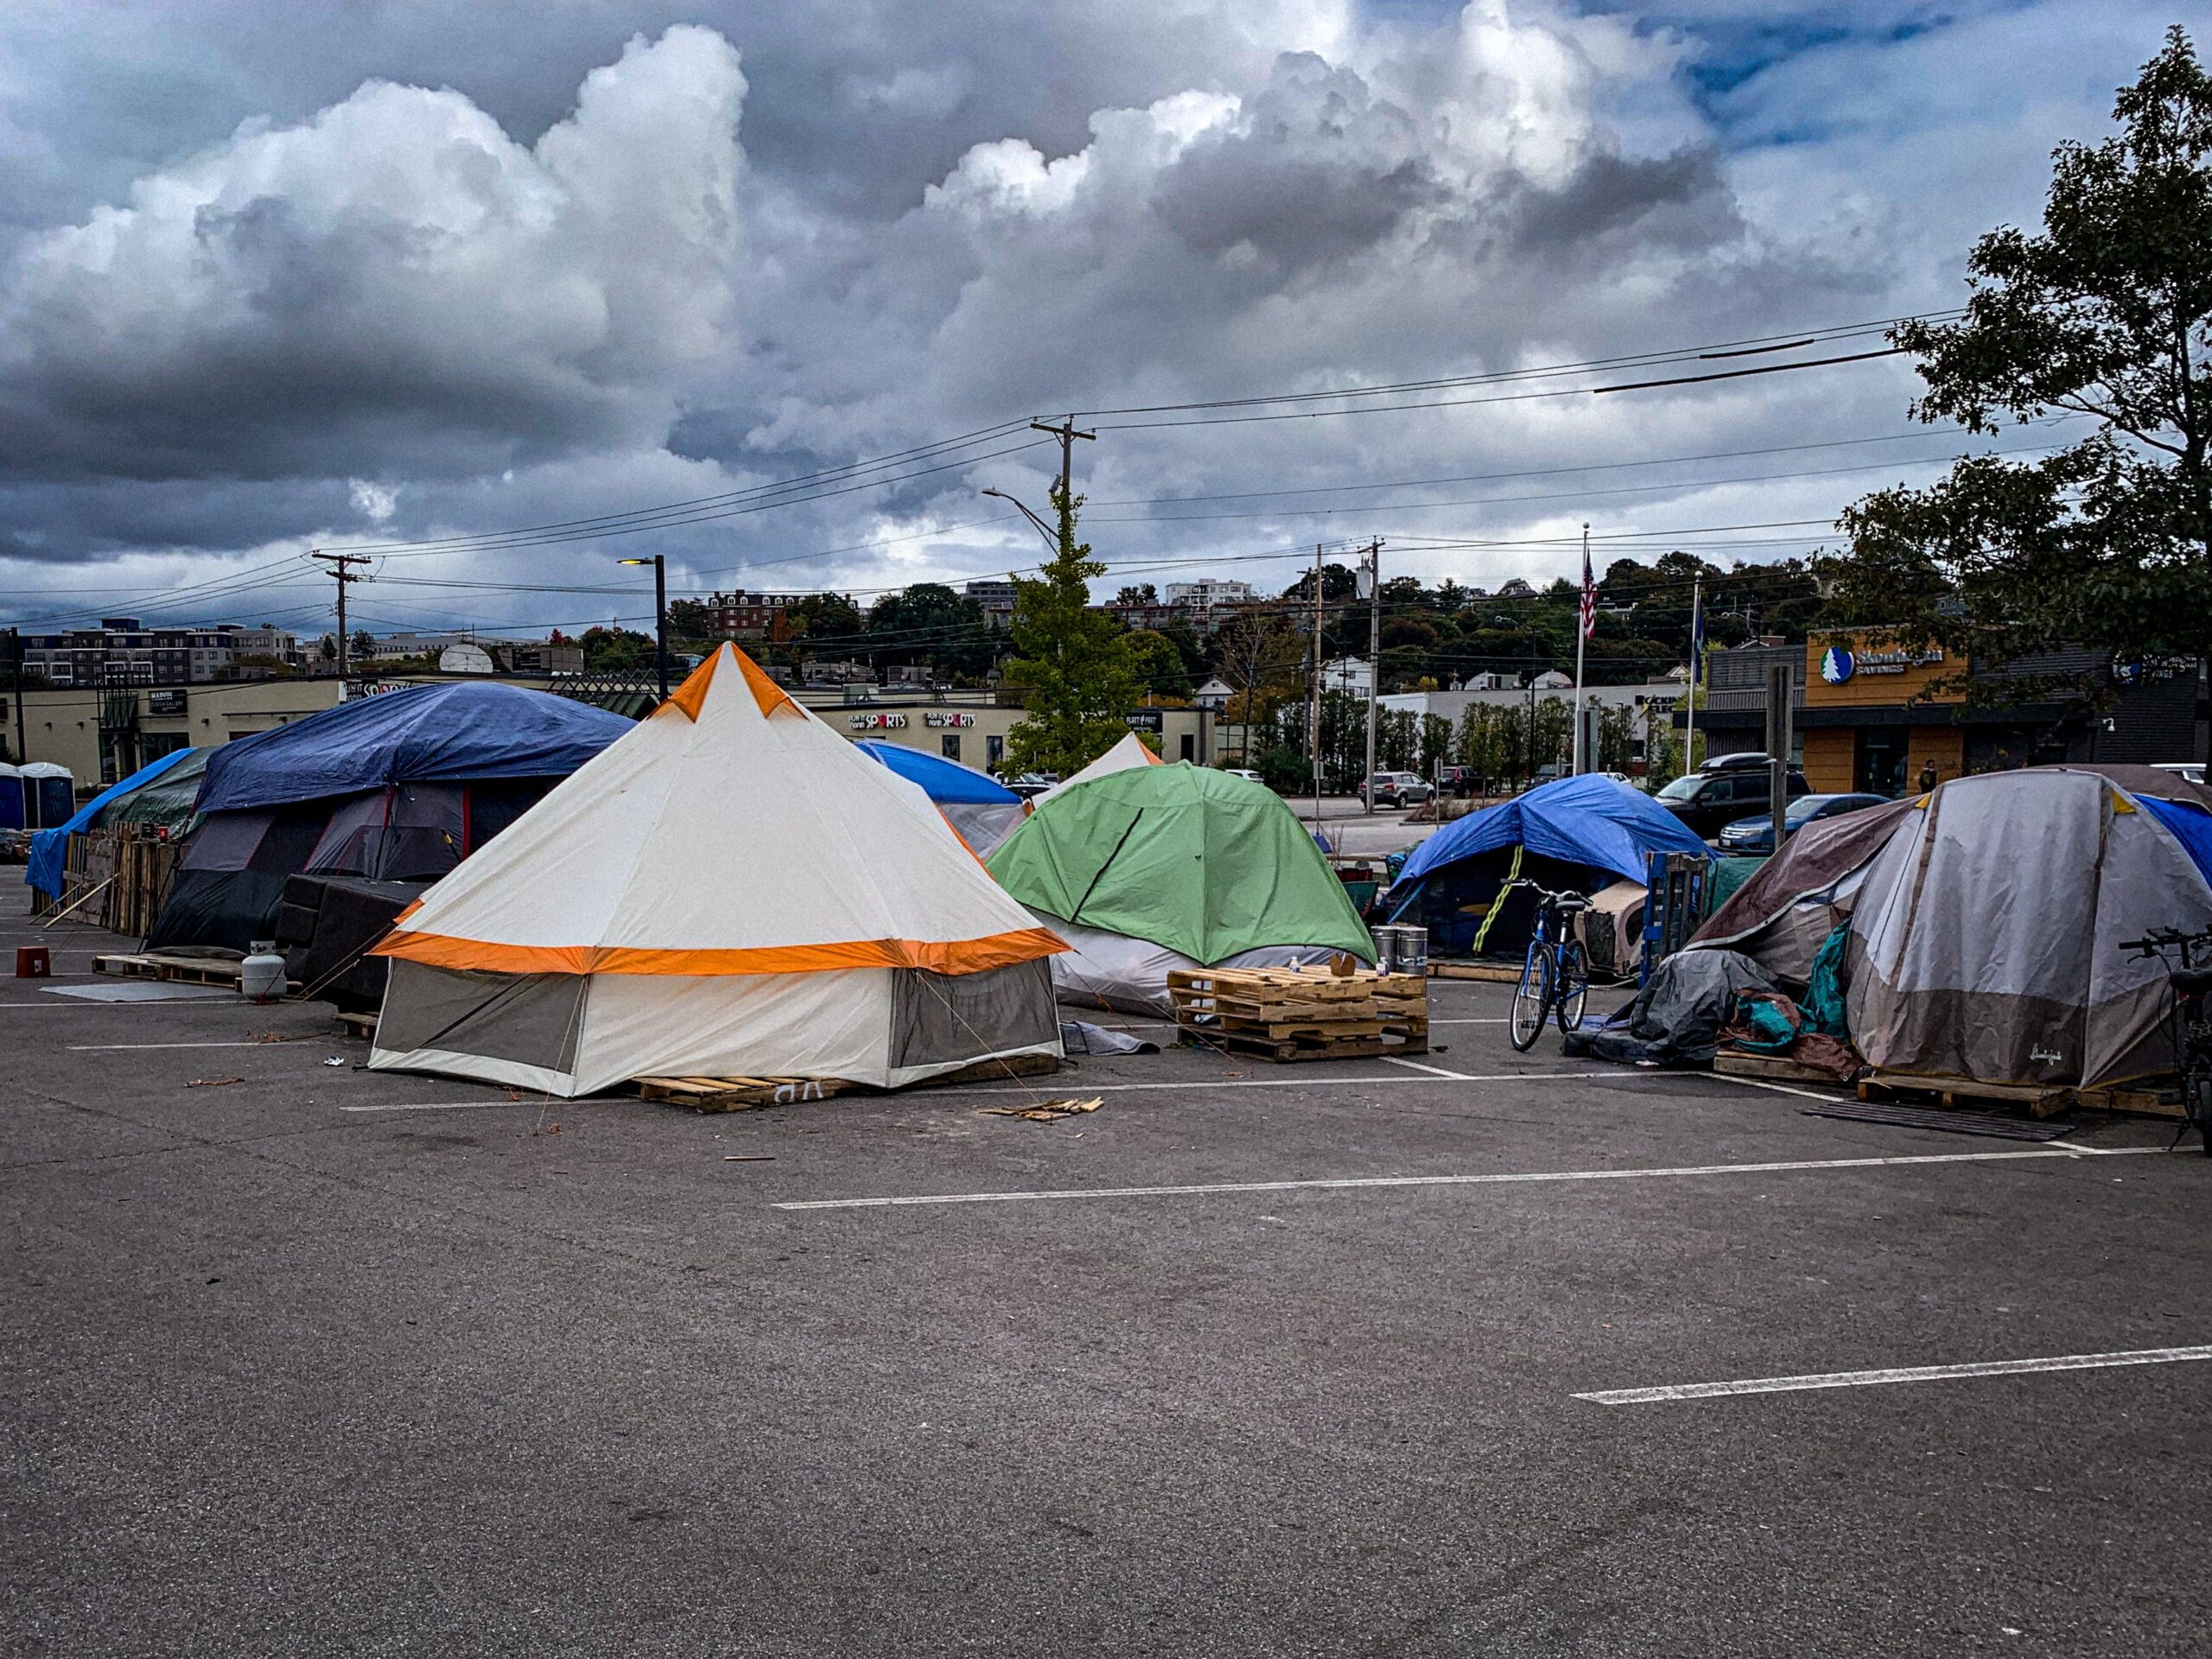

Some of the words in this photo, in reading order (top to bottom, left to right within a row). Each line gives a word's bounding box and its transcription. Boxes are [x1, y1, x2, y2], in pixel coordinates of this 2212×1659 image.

[1856, 664, 1904, 674] SAVINGS
[1635, 695, 1678, 706] ROCKIN
[866, 714, 906, 728] SPORTS
[943, 713, 976, 727] SPORTS
